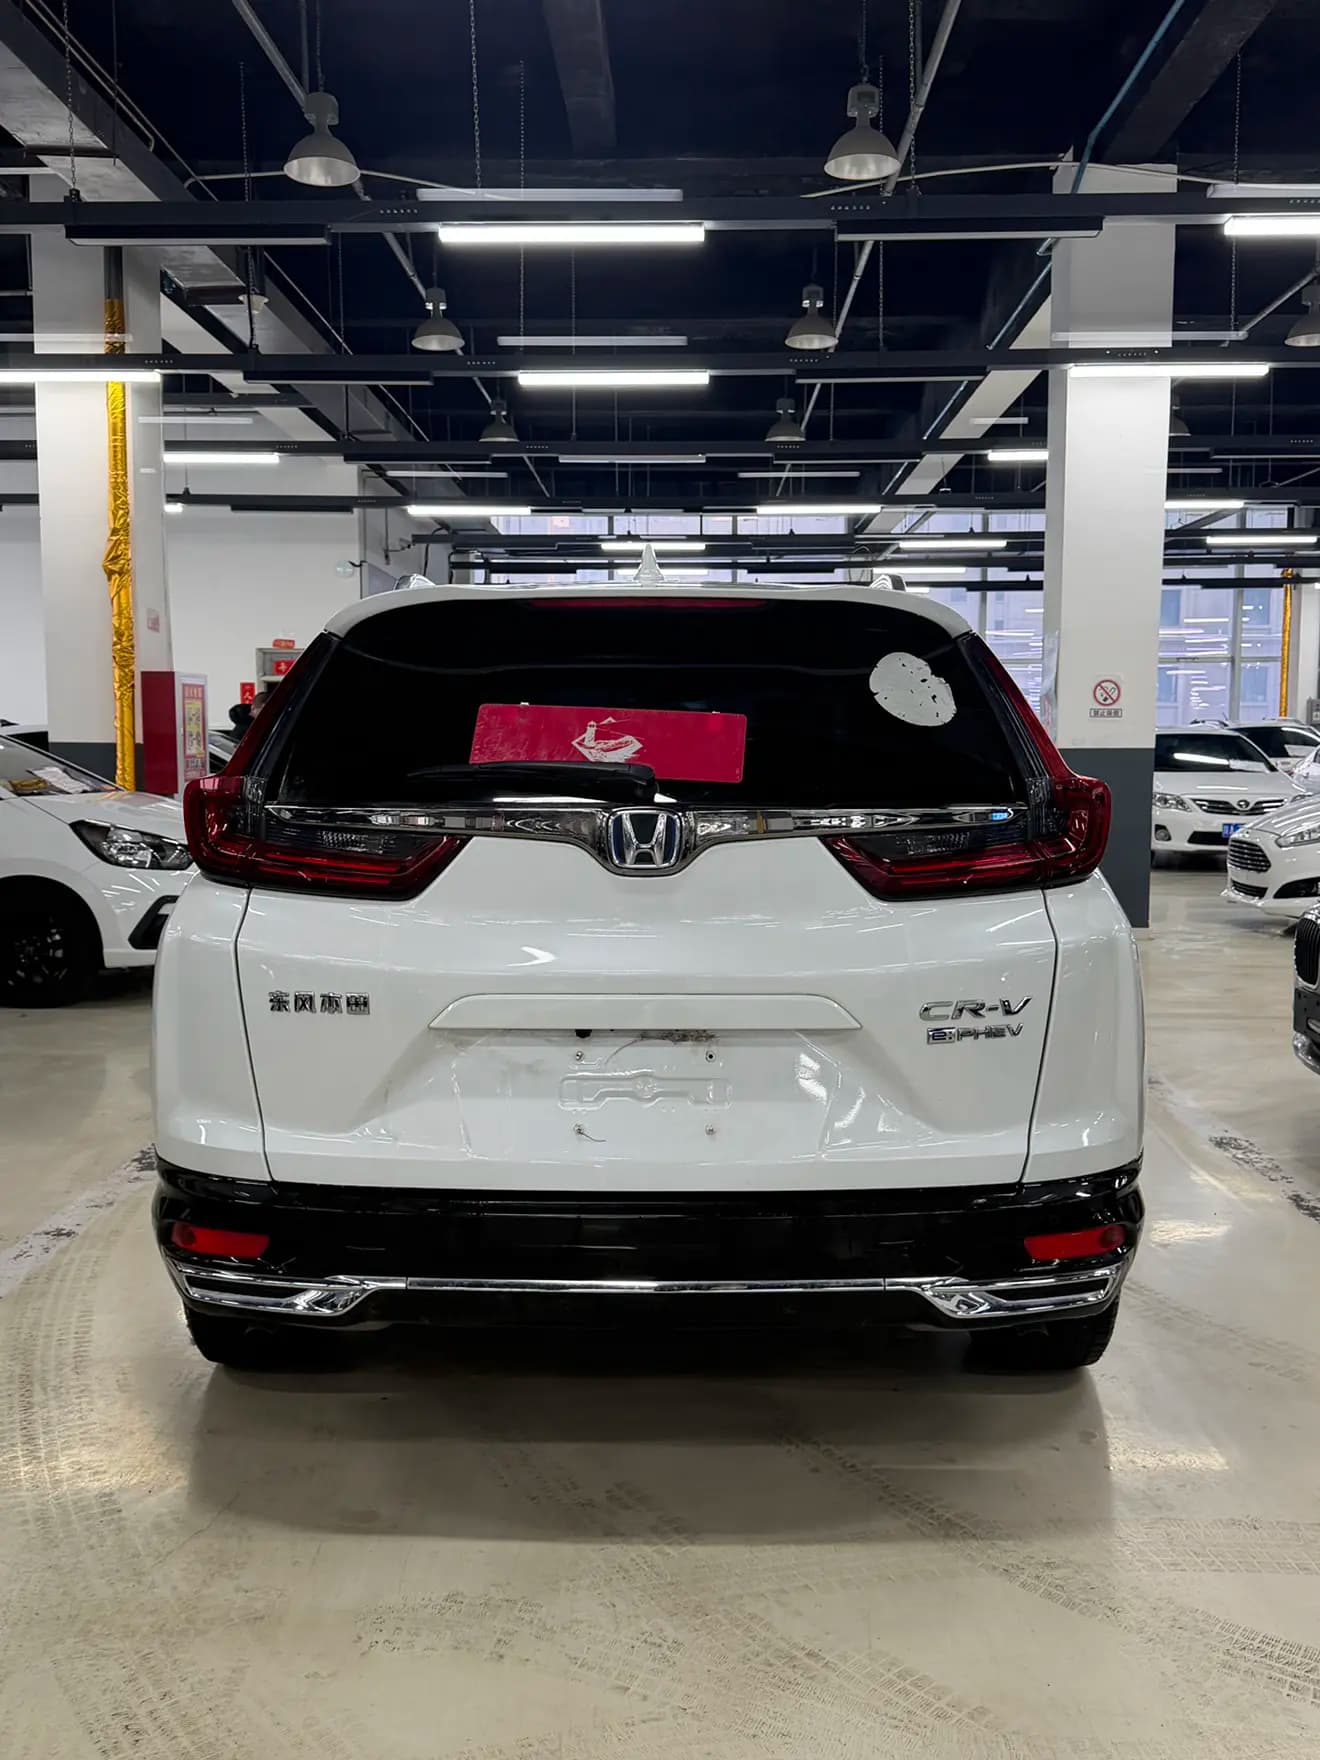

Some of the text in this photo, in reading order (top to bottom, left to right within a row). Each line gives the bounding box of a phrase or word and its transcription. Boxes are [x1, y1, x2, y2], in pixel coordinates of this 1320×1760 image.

[268, 990, 370, 1015] 东风本田
[919, 996, 1032, 1021] CR-V
